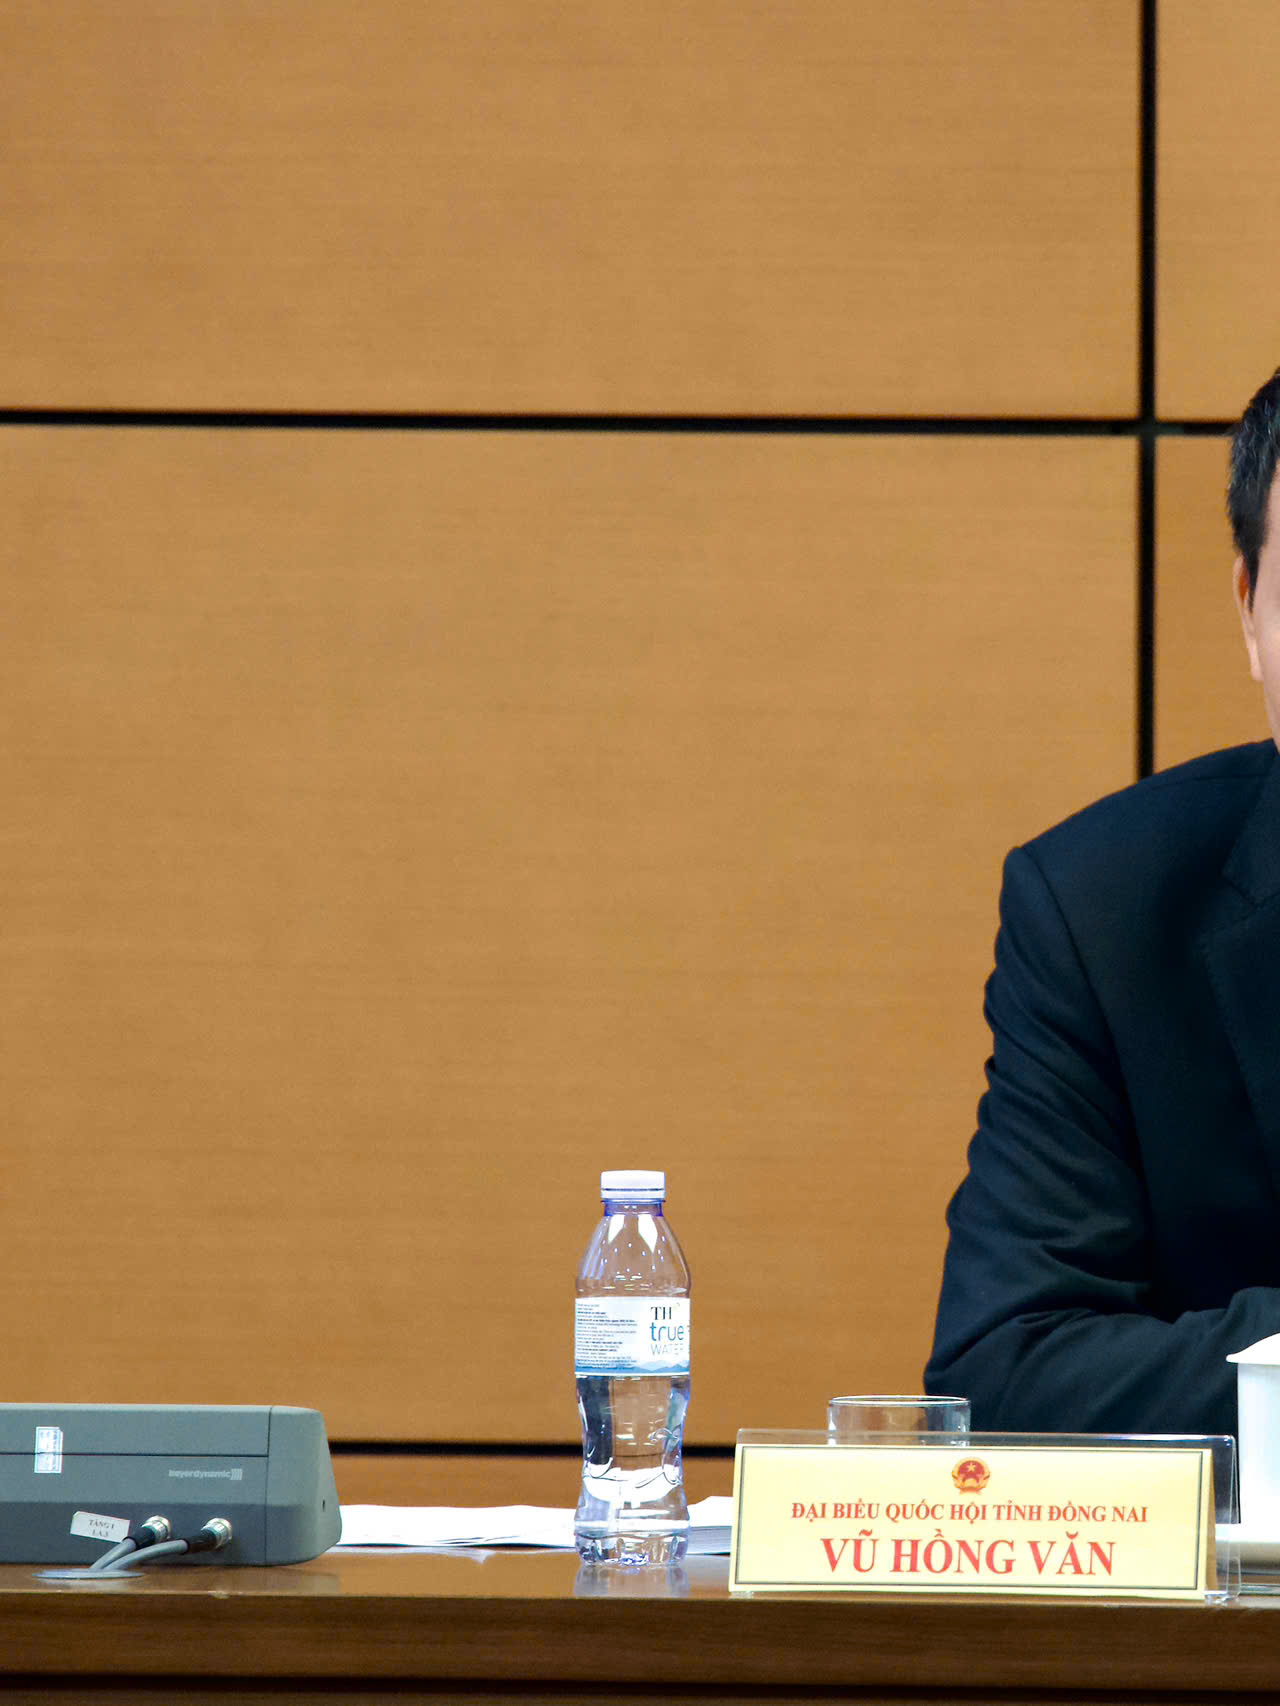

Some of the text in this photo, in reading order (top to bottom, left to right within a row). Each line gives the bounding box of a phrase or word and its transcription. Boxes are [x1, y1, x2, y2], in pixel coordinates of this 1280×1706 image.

[650, 1306, 673, 1321] TH
[649, 1322, 685, 1342] true
[791, 1502, 827, 1523] ĐẠI
[885, 1498, 945, 1523] QUỐC
[949, 1501, 987, 1525] HỘI
[992, 1499, 1043, 1522] TỈNH
[1111, 1505, 1148, 1523] NAI
[820, 1528, 1117, 1577] VŨ HỒNG VĂN
